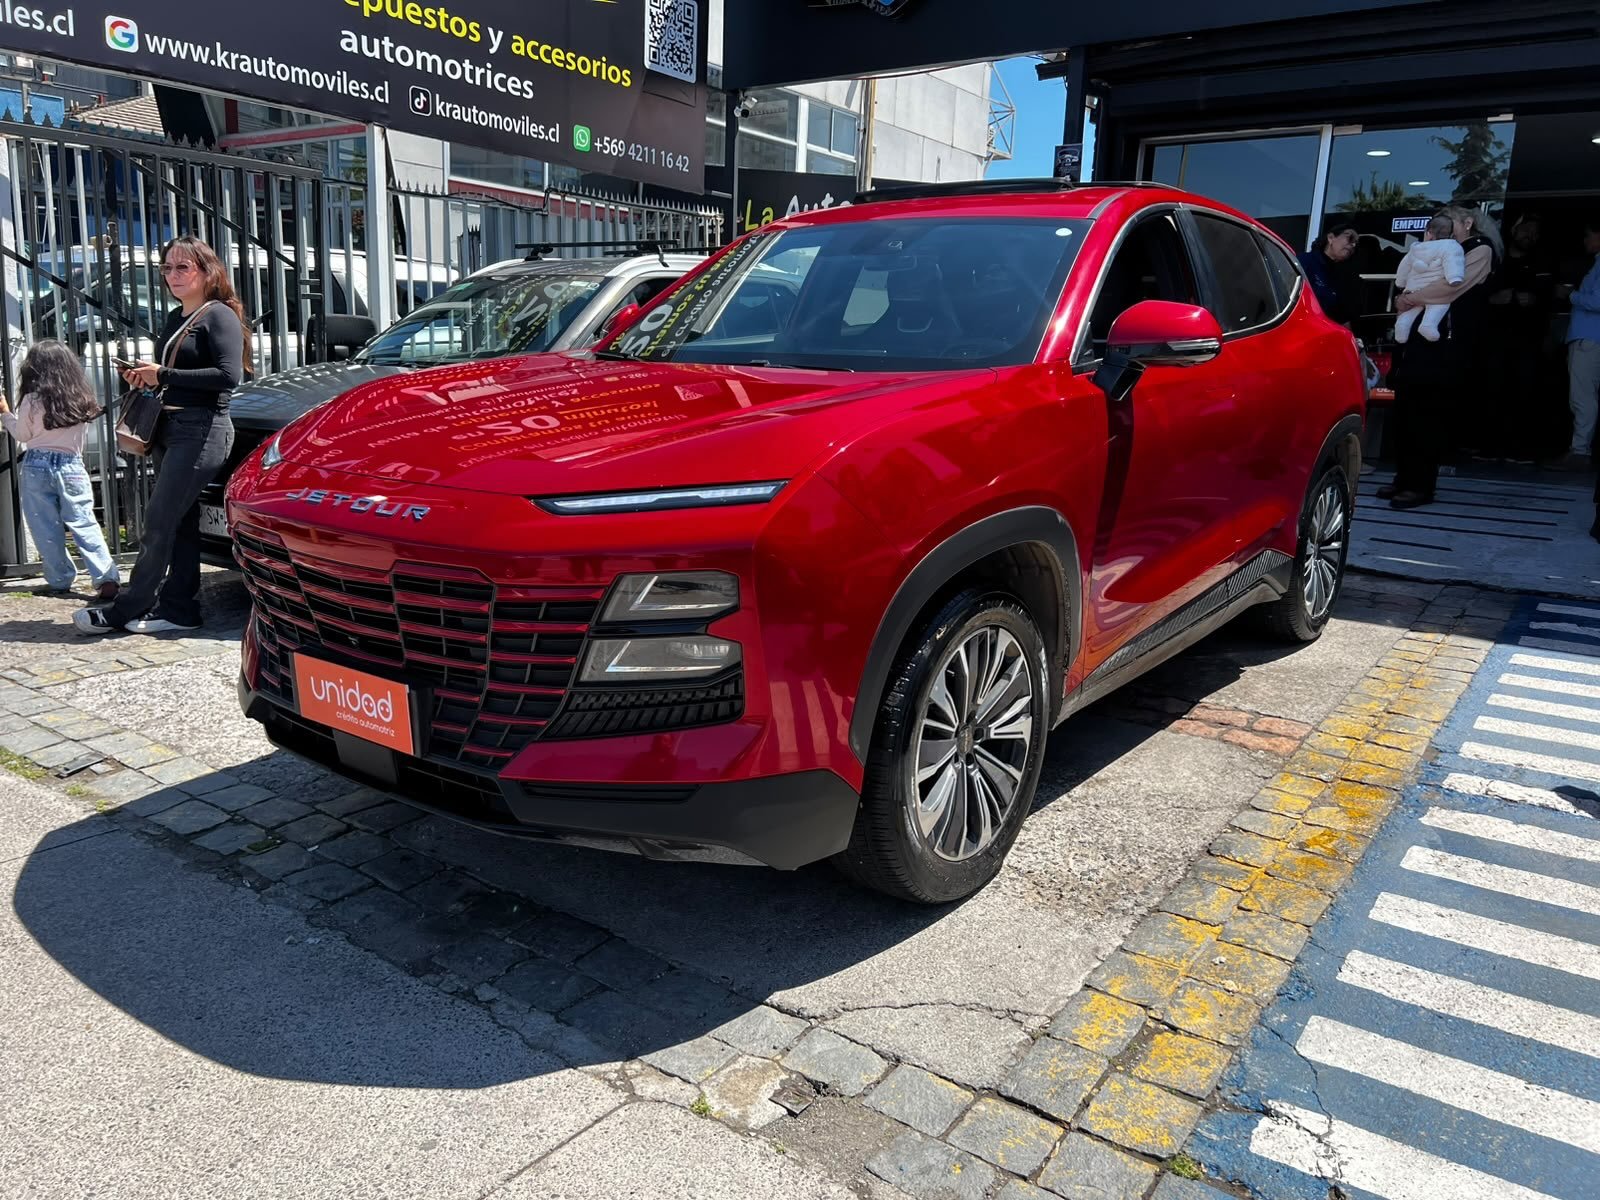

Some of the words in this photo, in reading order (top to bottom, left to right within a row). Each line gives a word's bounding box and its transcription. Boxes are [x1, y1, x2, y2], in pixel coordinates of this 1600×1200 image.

[145, 33, 390, 104] www.krautomoviles.cl
[340, 29, 534, 99] automotrices
[487, 26, 504, 54] y
[511, 35, 632, 88] accesorios
[435, 93, 560, 144] krautomoviles.cl
[594, 136, 626, 157] +569
[628, 143, 656, 165] 4211
[744, 199, 775, 231] La
[285, 486, 431, 520] JETOUR
[310, 675, 393, 723] unidad
[359, 718, 396, 738] automotriz
